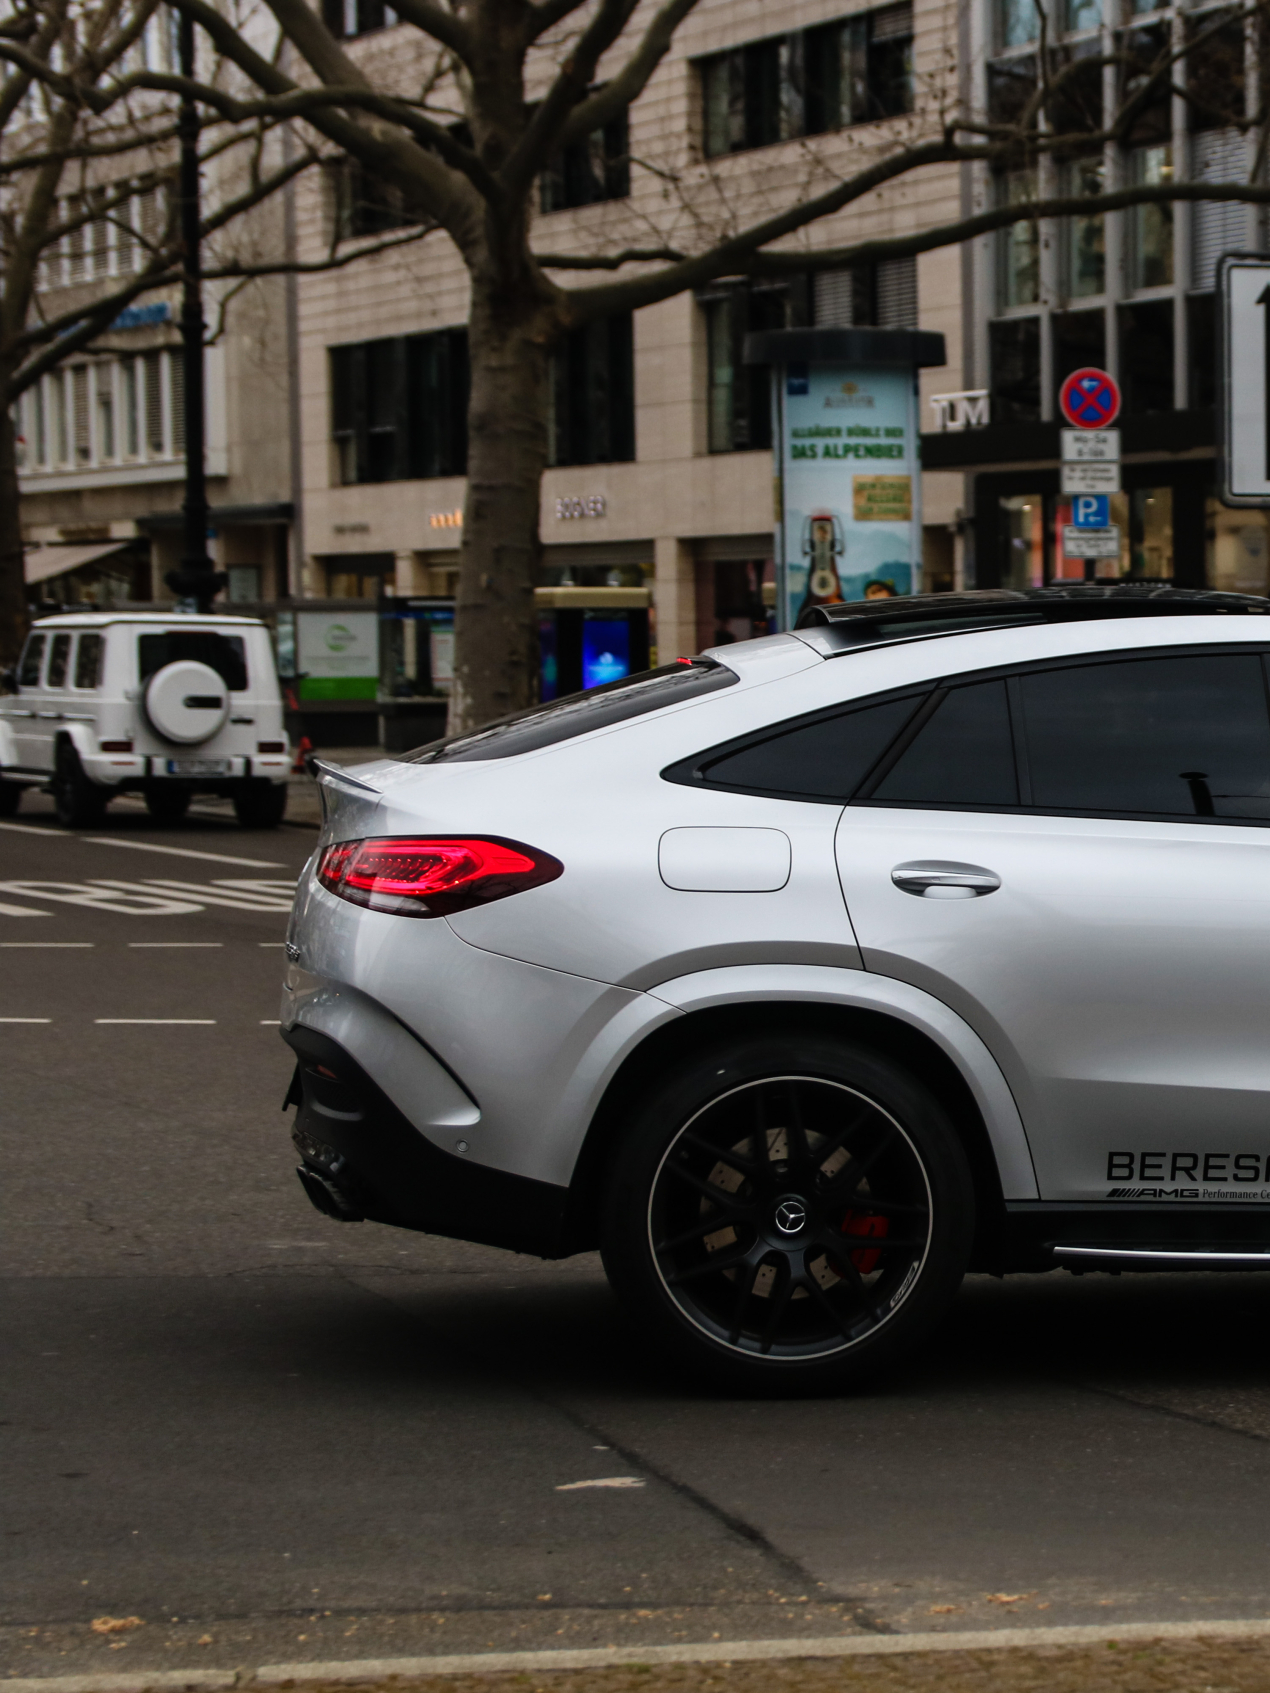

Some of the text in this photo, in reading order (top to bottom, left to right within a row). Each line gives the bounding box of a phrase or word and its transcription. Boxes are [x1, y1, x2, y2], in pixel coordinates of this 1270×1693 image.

[791, 443, 904, 460] DAS ALPENBIER
[1202, 1188, 1259, 1200] Performance
